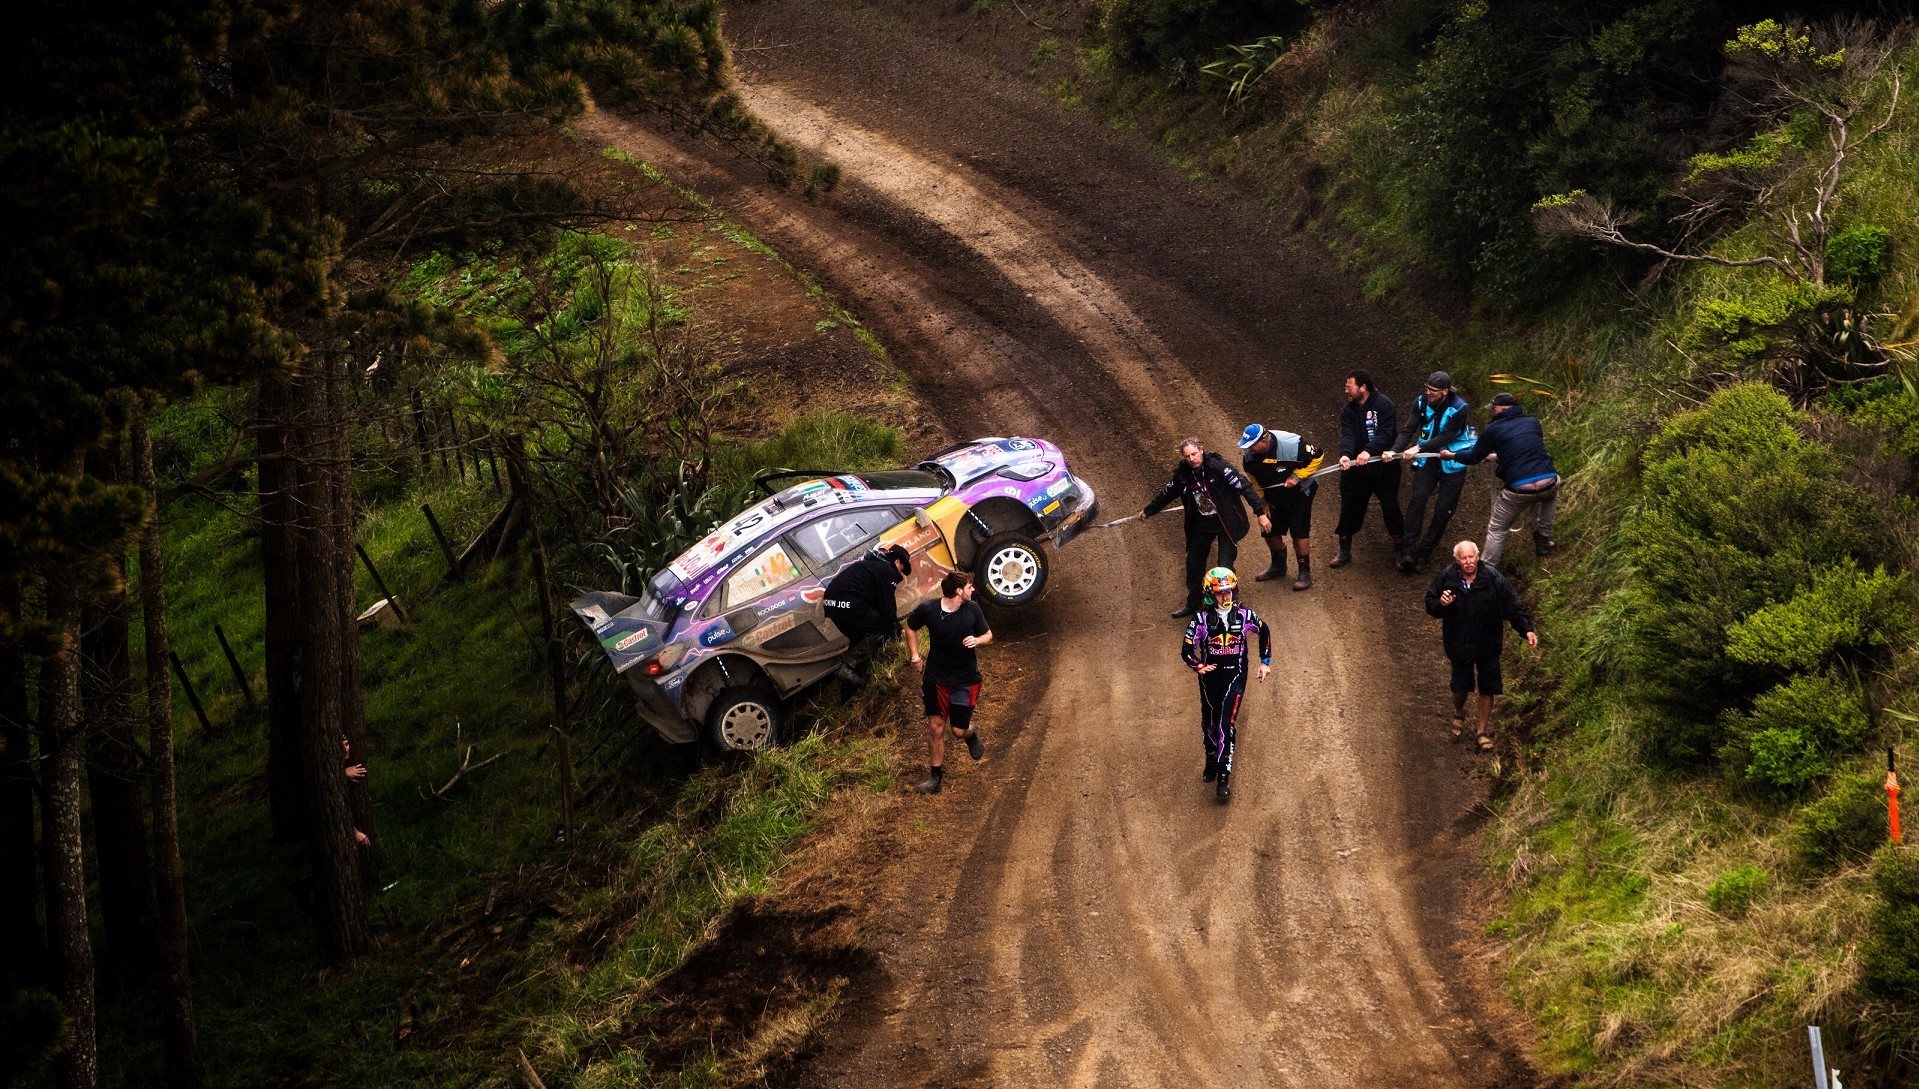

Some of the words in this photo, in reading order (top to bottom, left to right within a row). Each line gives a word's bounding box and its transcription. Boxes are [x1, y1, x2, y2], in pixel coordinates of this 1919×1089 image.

[731, 513, 764, 536] 42
[900, 530, 931, 549] KLAND
[769, 552, 787, 575] 42
[1011, 543, 1042, 569] SCORPION
[757, 600, 786, 616] ROCKDOOR
[623, 630, 647, 648] Castrol
[707, 630, 726, 643] pulse
[755, 618, 793, 643] Castrol
[1209, 646, 1225, 655] Red
[1225, 646, 1239, 655] Bull
